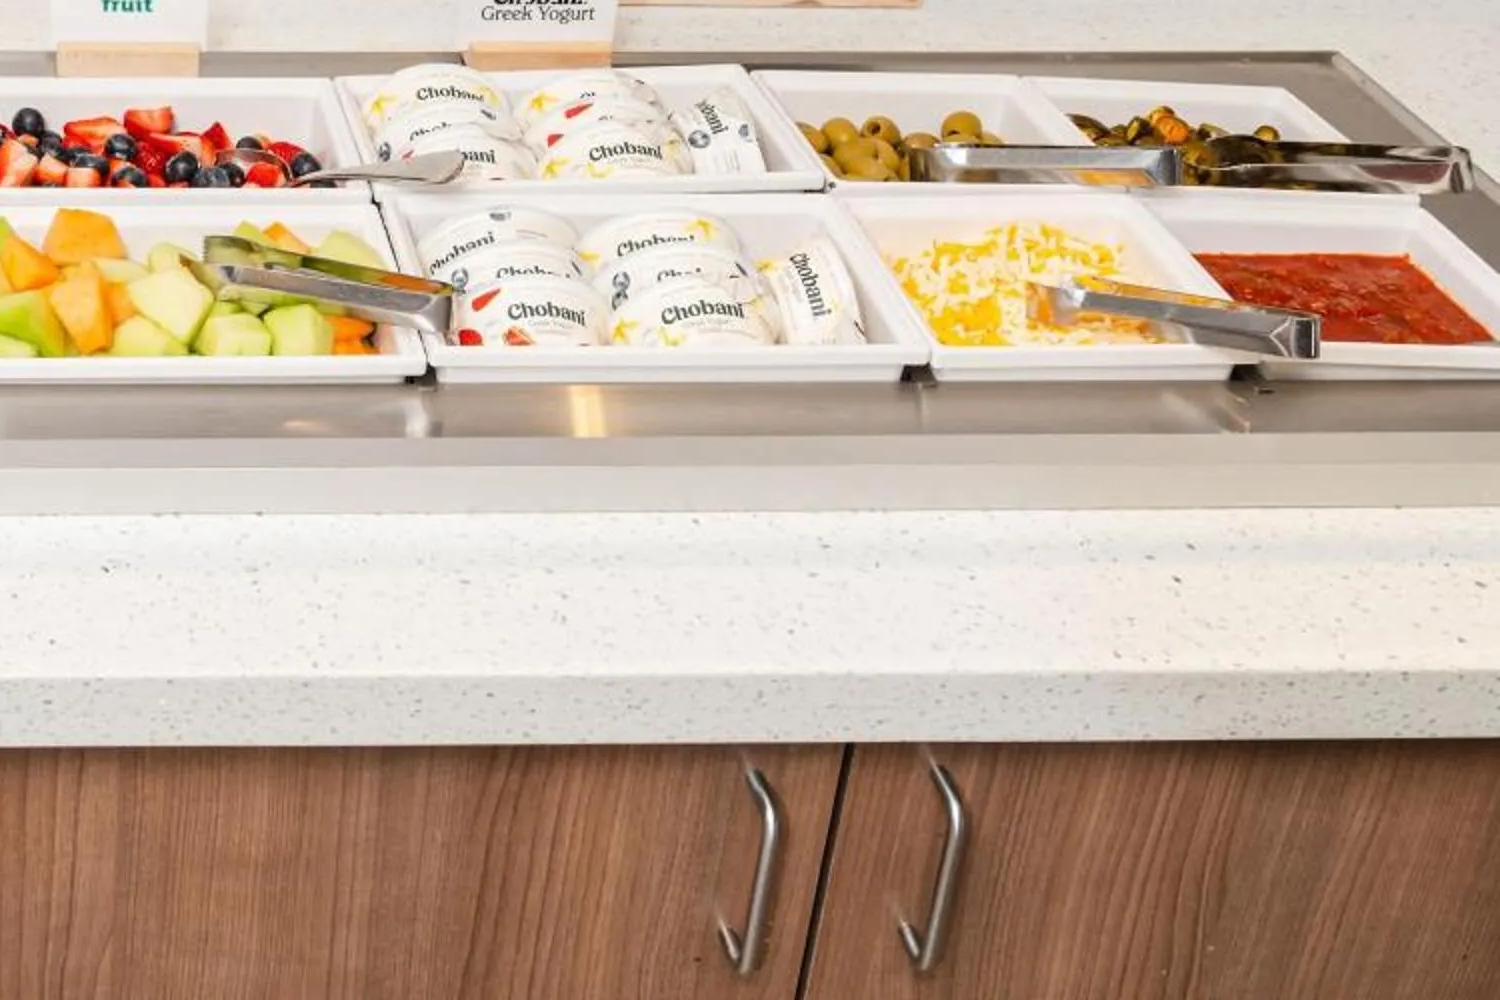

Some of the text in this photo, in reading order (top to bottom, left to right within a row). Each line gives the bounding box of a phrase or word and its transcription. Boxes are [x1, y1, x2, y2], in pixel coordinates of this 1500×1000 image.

[481, 6, 596, 25] Greek Yogurt
[589, 140, 663, 161] Chobani
[789, 253, 832, 317] Chobani
[507, 301, 586, 327] Chobani
[660, 299, 745, 325] Chobani
